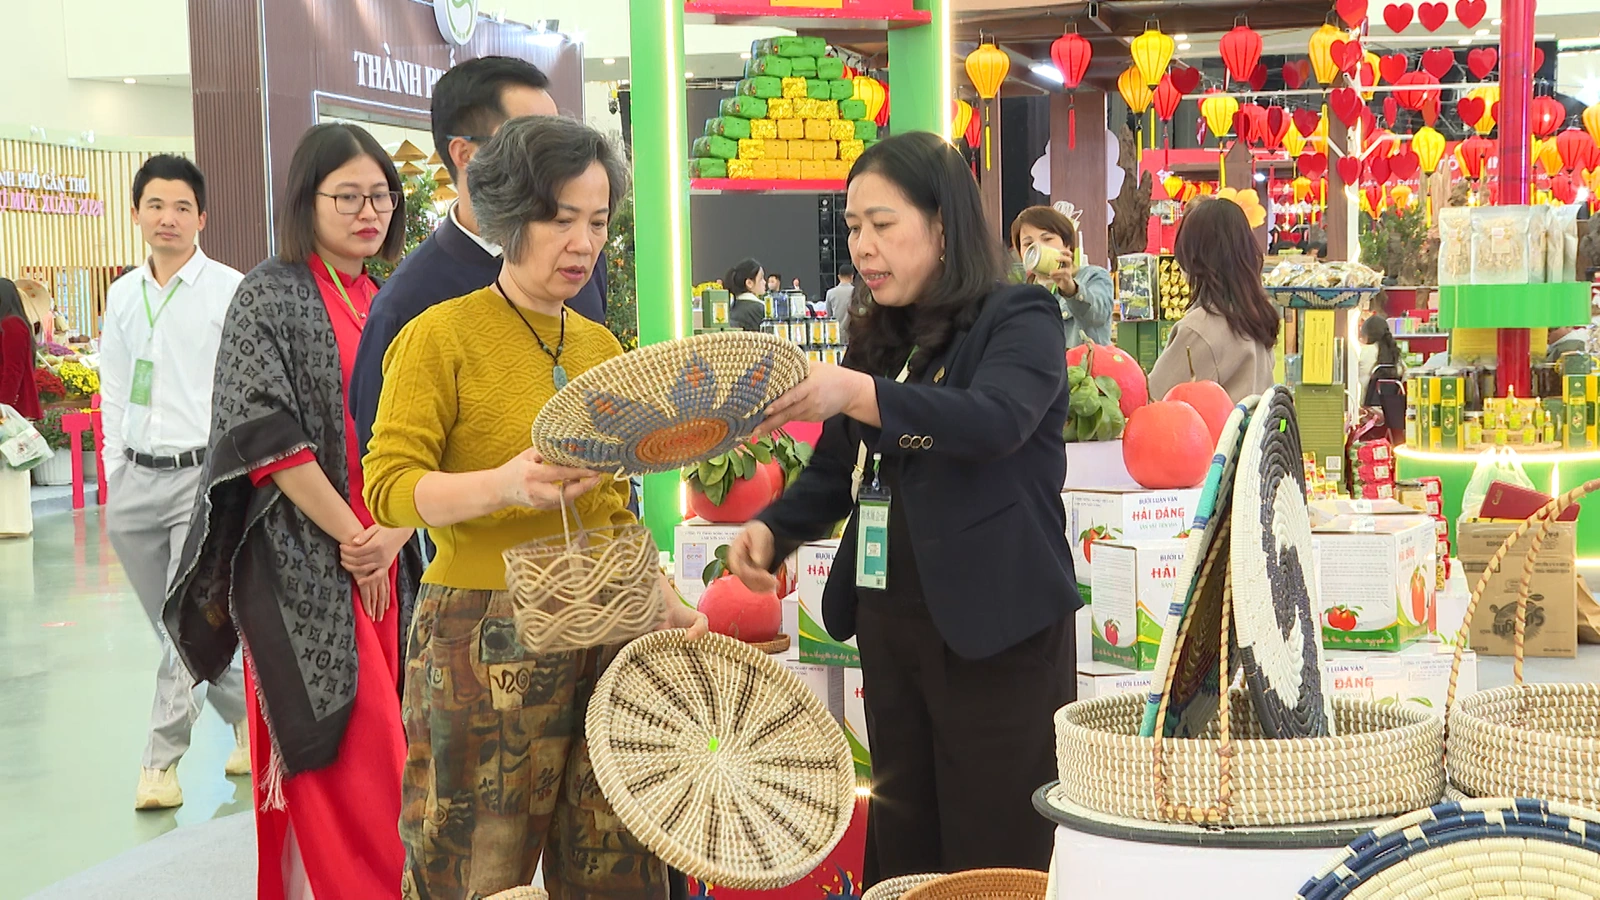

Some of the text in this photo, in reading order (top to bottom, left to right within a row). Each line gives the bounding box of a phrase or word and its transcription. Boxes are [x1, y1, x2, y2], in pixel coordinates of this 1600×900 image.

[354, 42, 423, 98] THÀNH
[18, 163, 40, 189] PHỐ
[42, 167, 66, 192] CẦN
[11, 188, 38, 211] MÙA
[41, 192, 75, 214] XUÂN
[1132, 506, 1185, 521] HẢI ĐĂNG
[1151, 563, 1177, 579] HẢI
[1334, 675, 1374, 689] ĐĂNG
